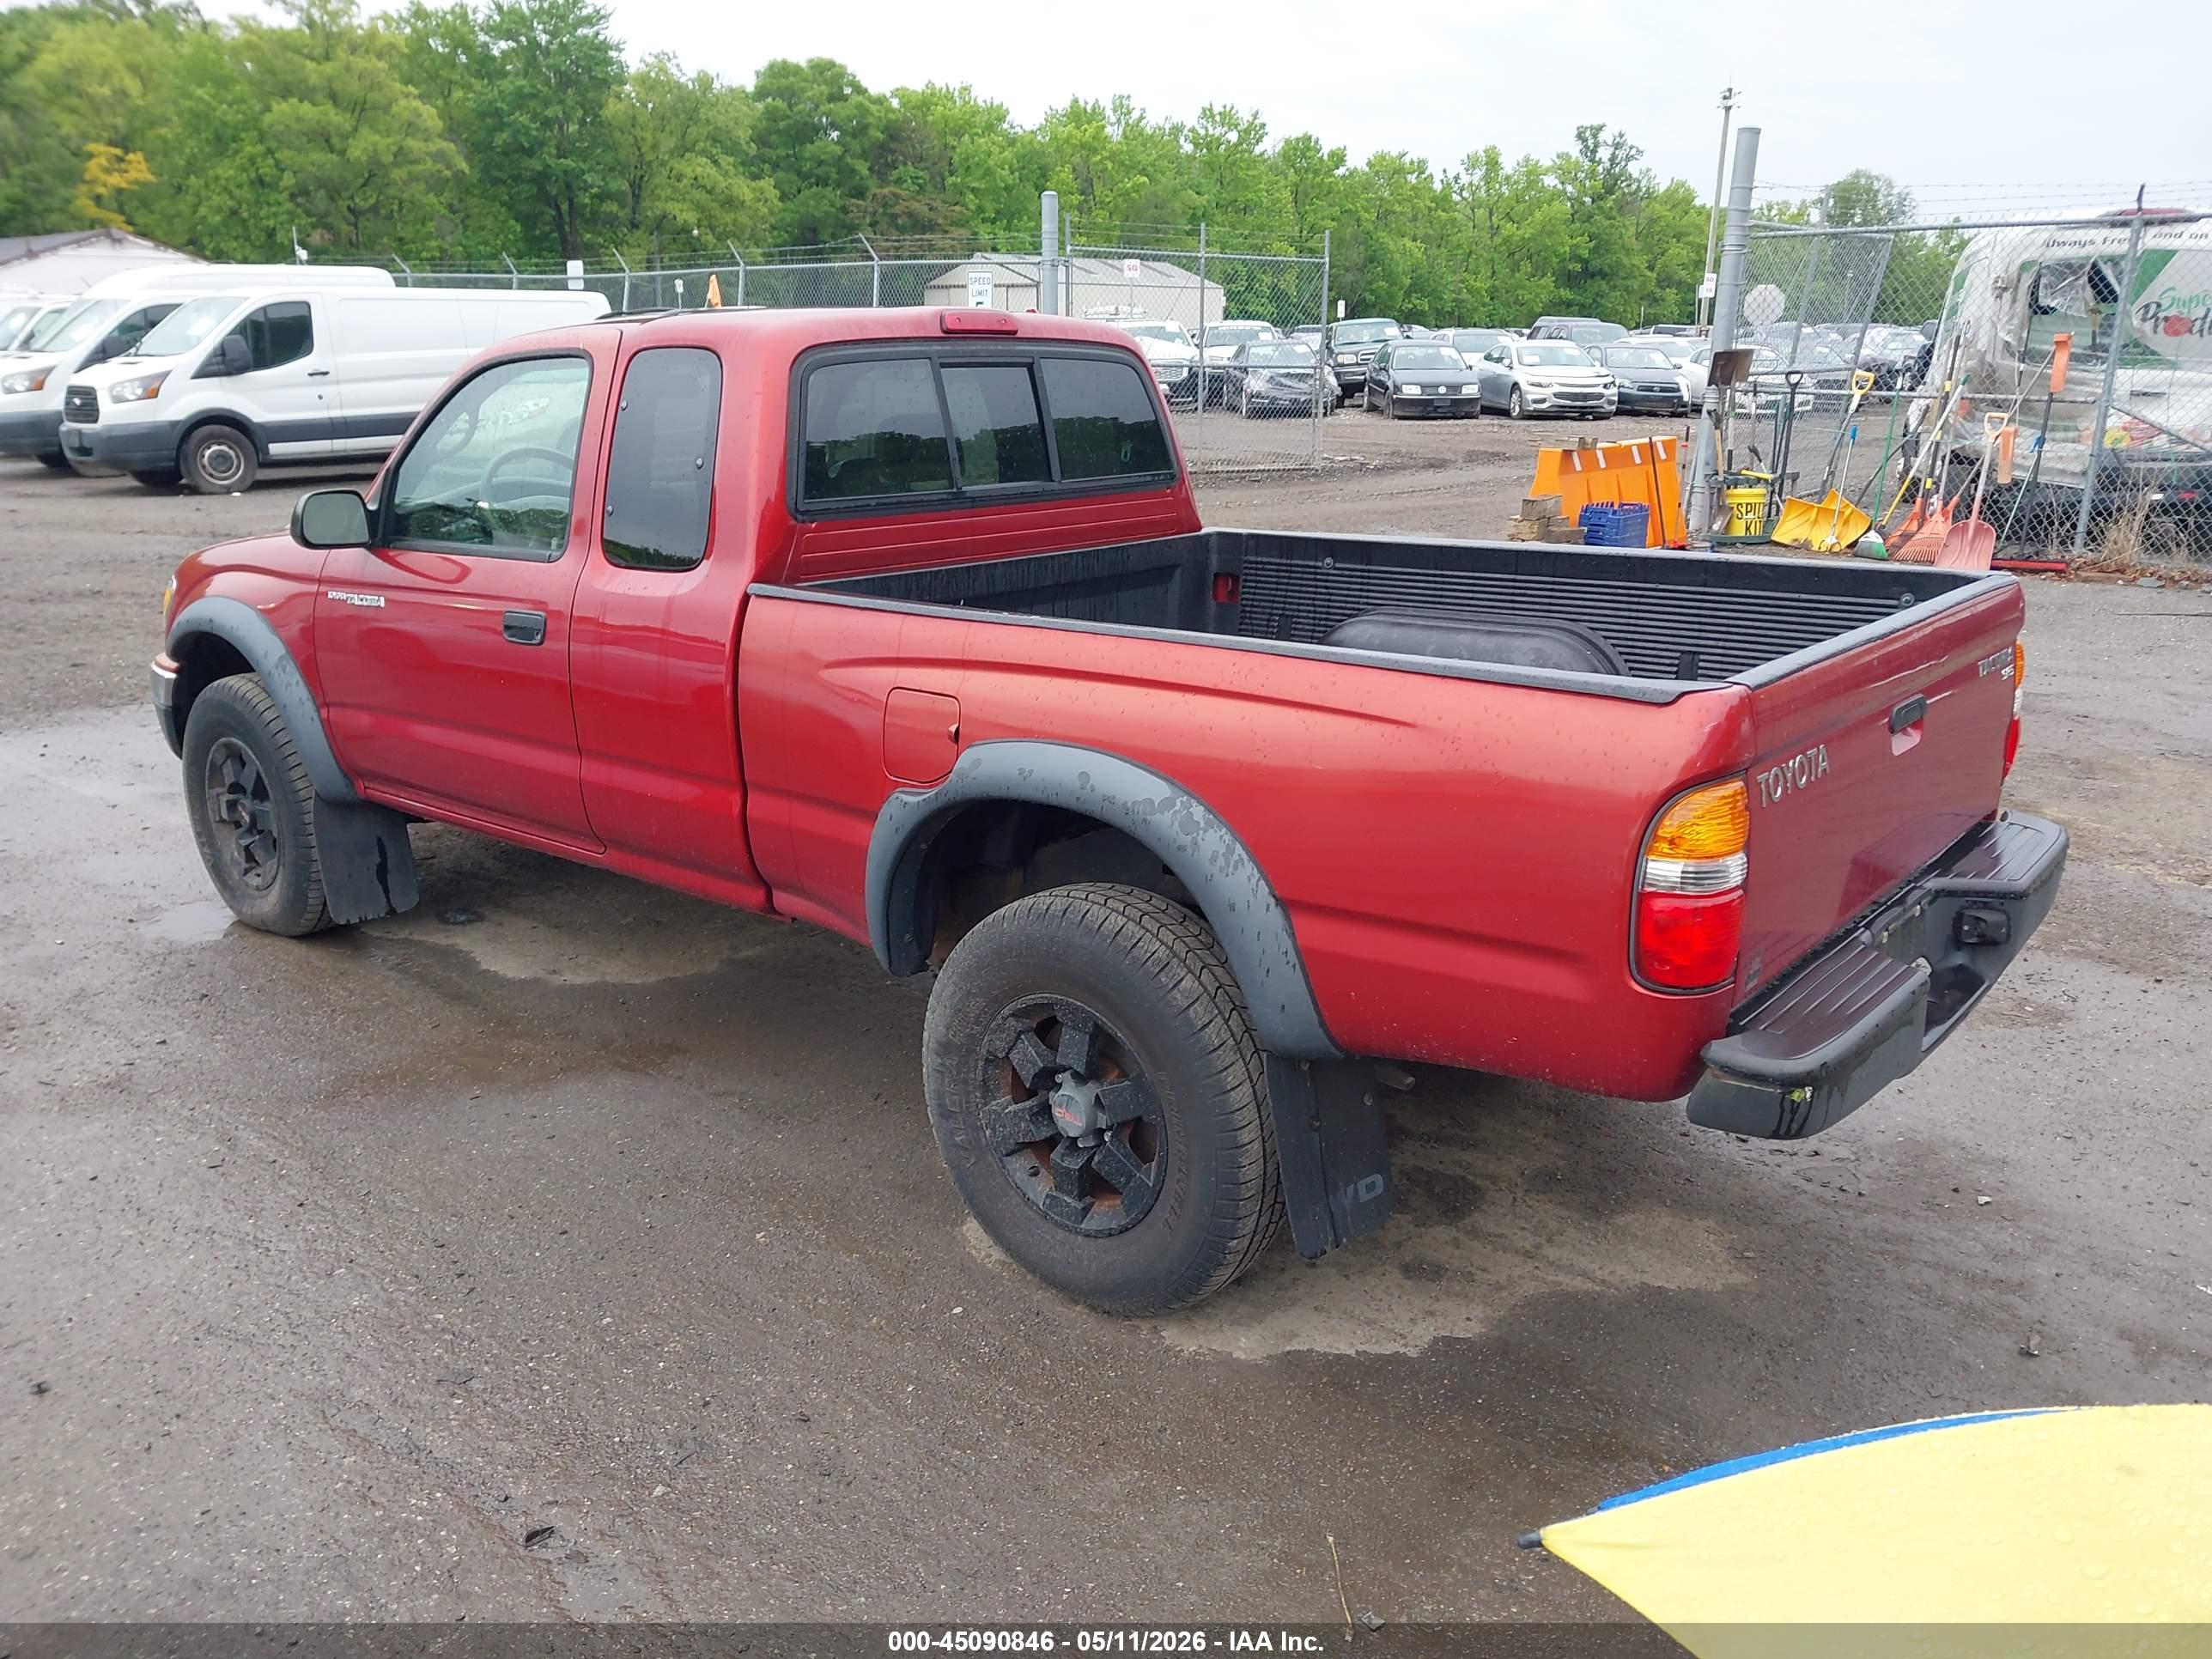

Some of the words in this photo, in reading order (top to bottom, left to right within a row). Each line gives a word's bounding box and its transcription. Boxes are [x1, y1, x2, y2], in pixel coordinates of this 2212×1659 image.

[969, 276, 991, 285] SPEED
[971, 289, 988, 297] LIMIT
[1744, 520, 1763, 536] KIT
[1755, 743, 1831, 809] TOYOTA
